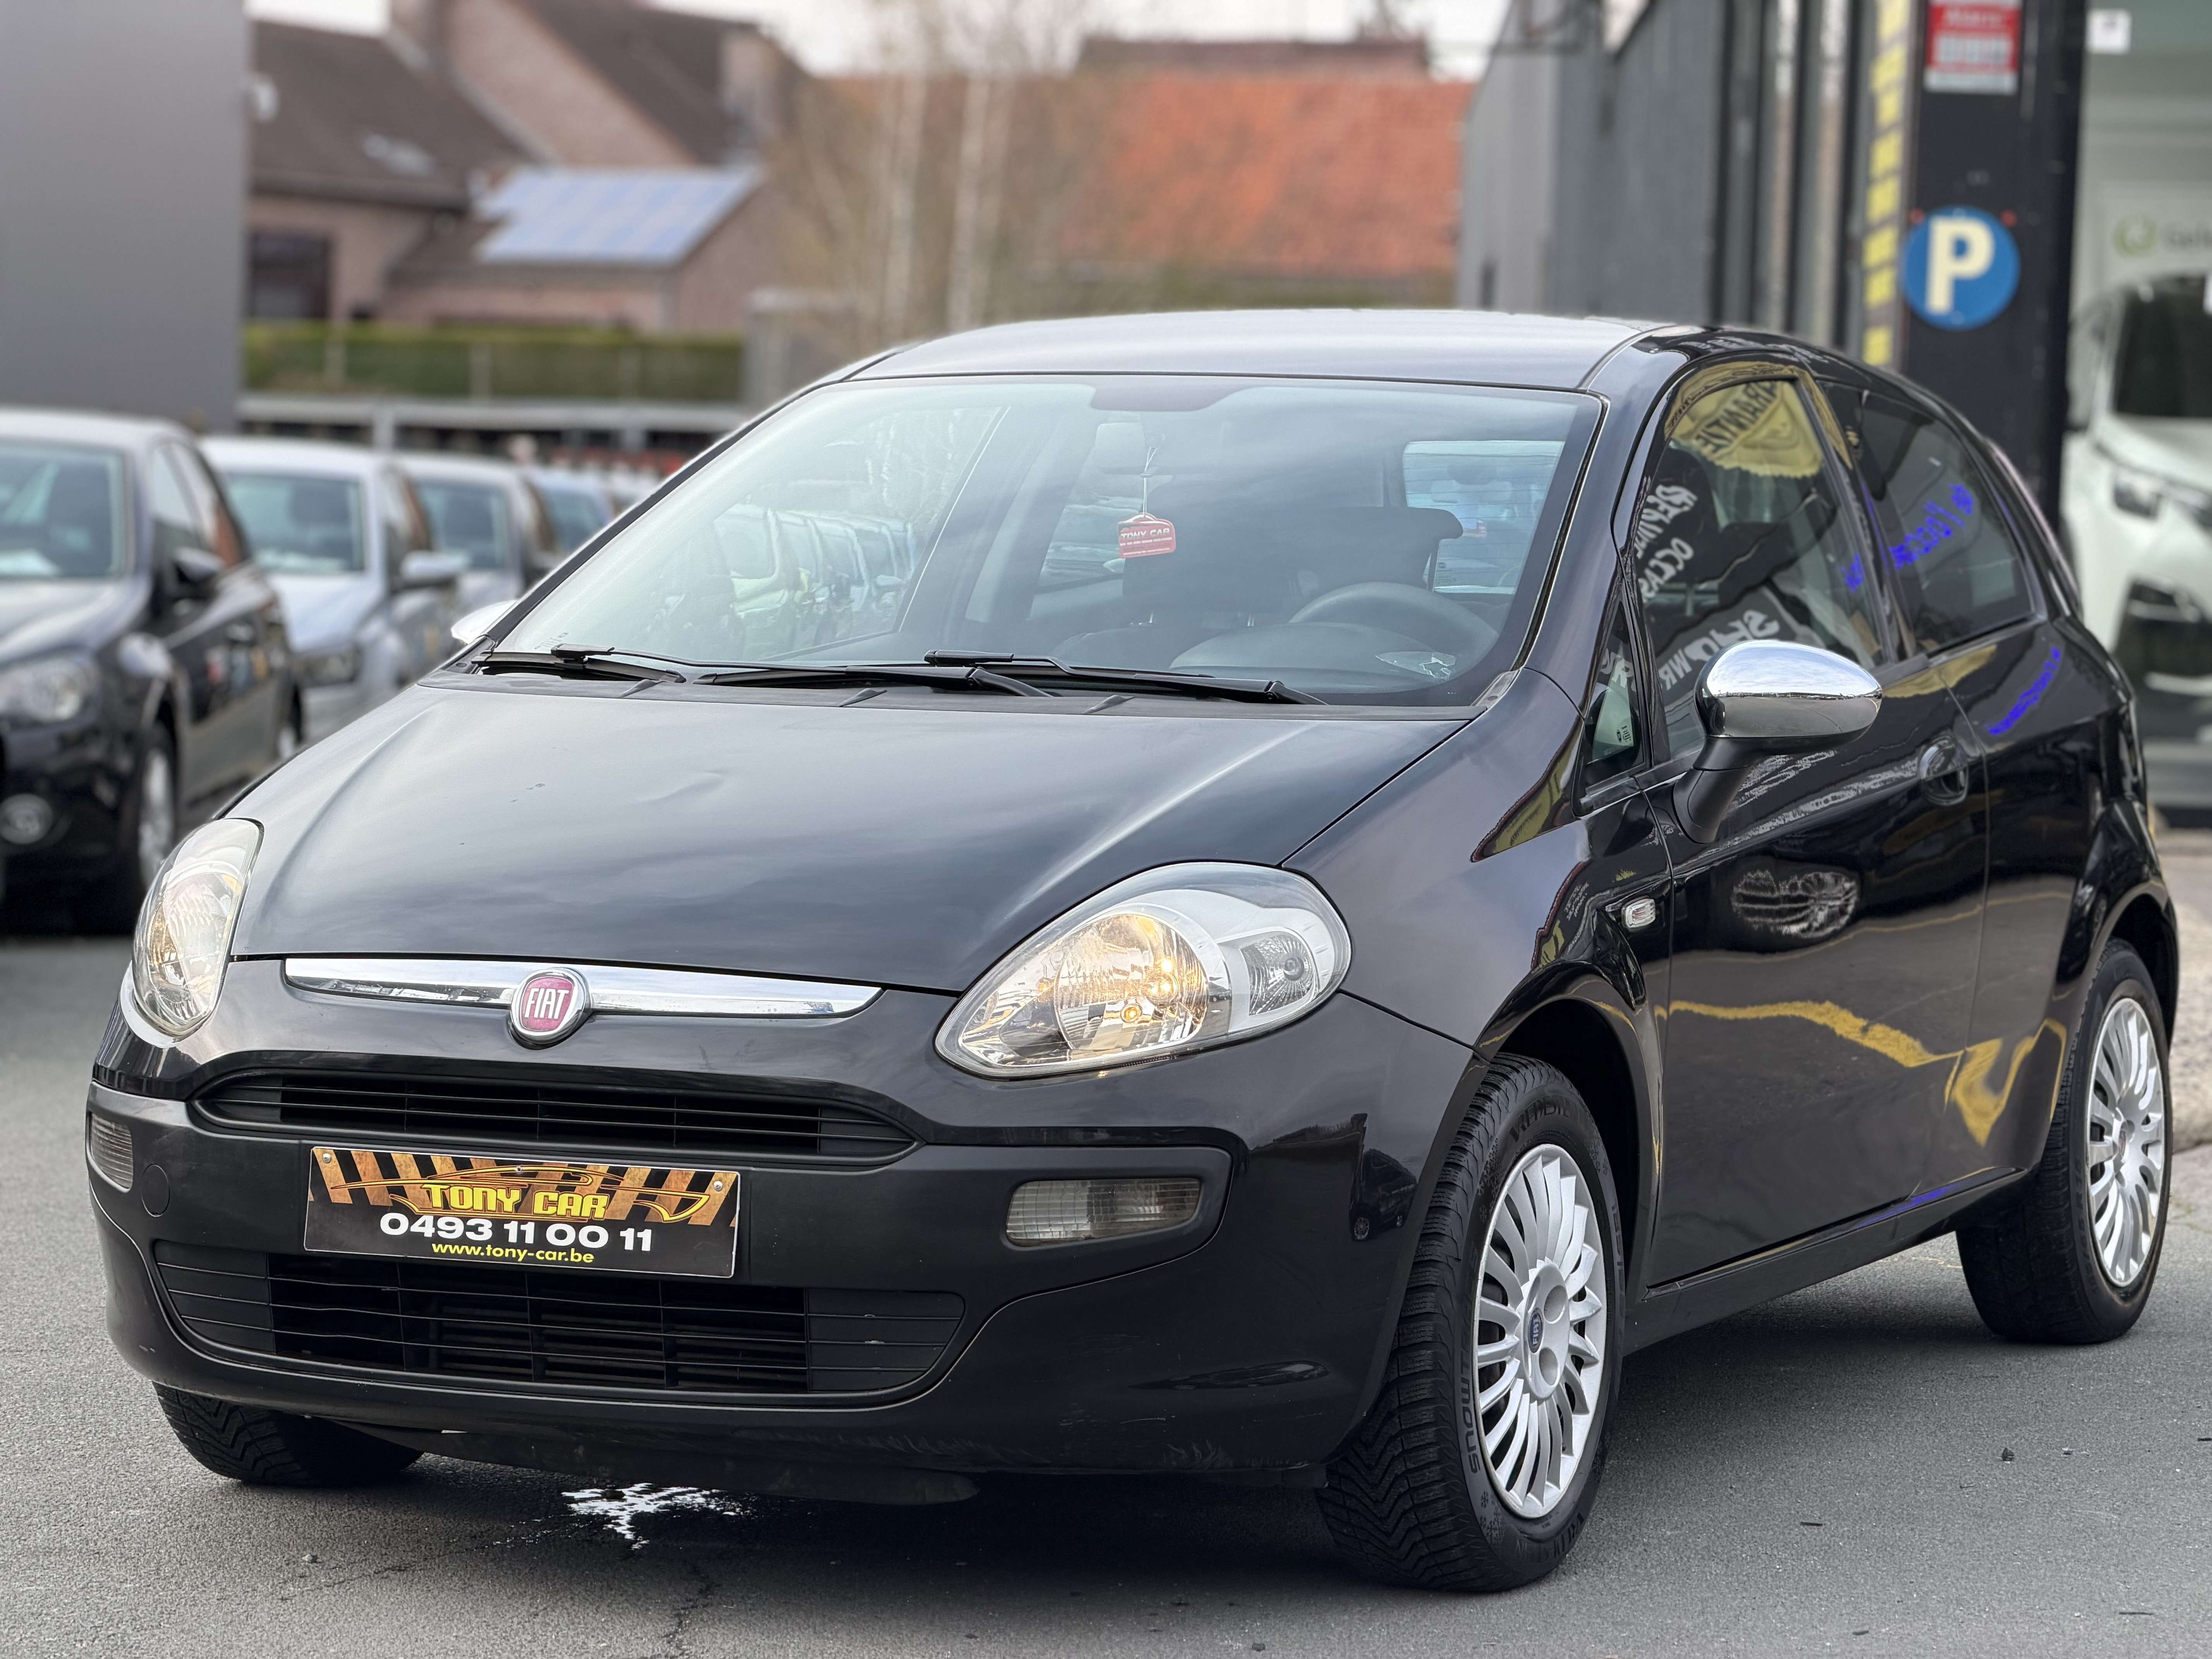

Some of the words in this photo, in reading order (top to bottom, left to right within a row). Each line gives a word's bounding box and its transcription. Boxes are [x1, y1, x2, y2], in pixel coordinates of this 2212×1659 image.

[1925, 216, 1995, 314] P
[524, 988, 570, 1019] FIAT
[422, 1183, 520, 1212] TONY
[533, 1190, 610, 1221] CAR
[380, 1212, 493, 1242] 0493
[503, 1221, 534, 1243] 11
[545, 1224, 609, 1248] 00
[620, 1228, 653, 1252] 11
[432, 1242, 595, 1264] www.tony-car.be
